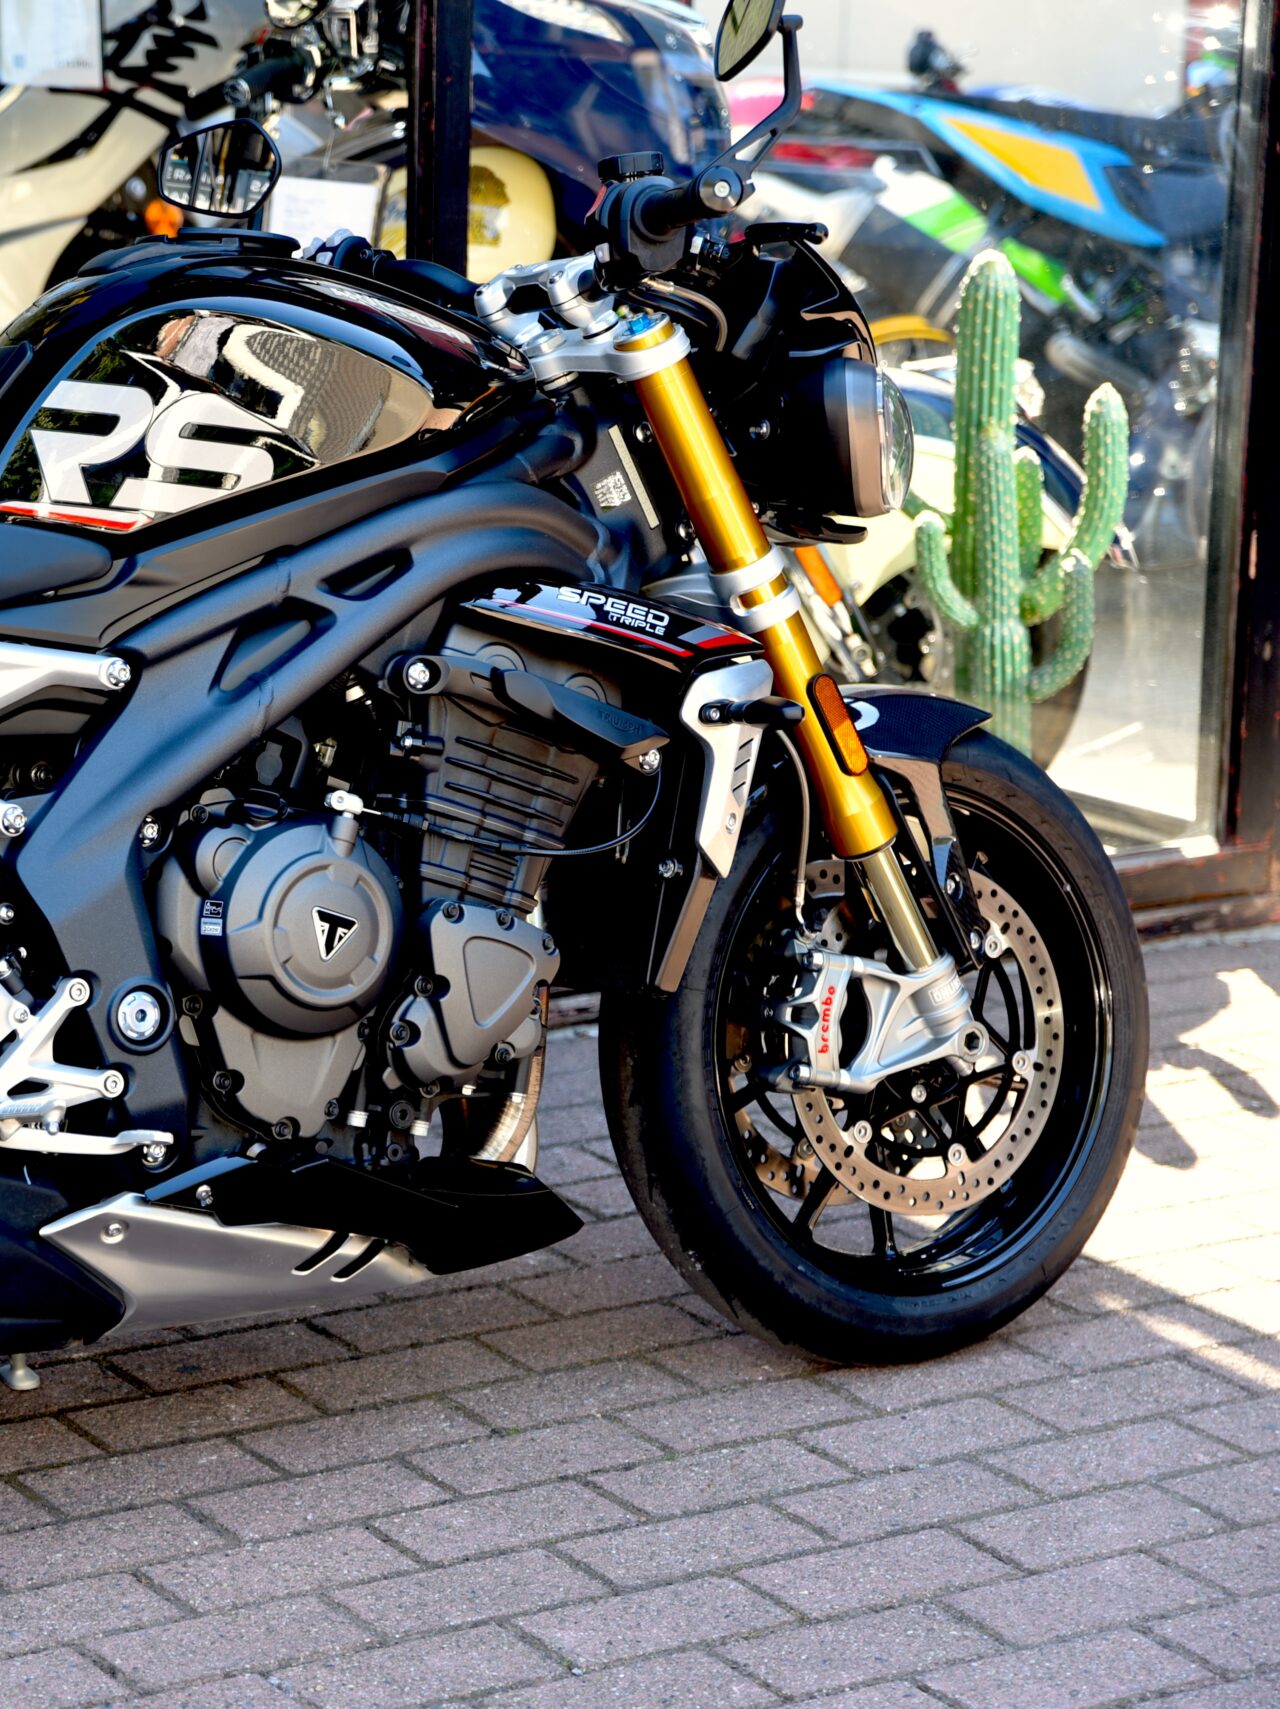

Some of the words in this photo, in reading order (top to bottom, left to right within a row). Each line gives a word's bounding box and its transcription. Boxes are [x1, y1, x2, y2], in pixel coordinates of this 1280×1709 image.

[29, 379, 275, 514] RS
[557, 586, 669, 628] SPEED
[608, 612, 666, 636] TRIPLE
[818, 986, 836, 1054] brembo
